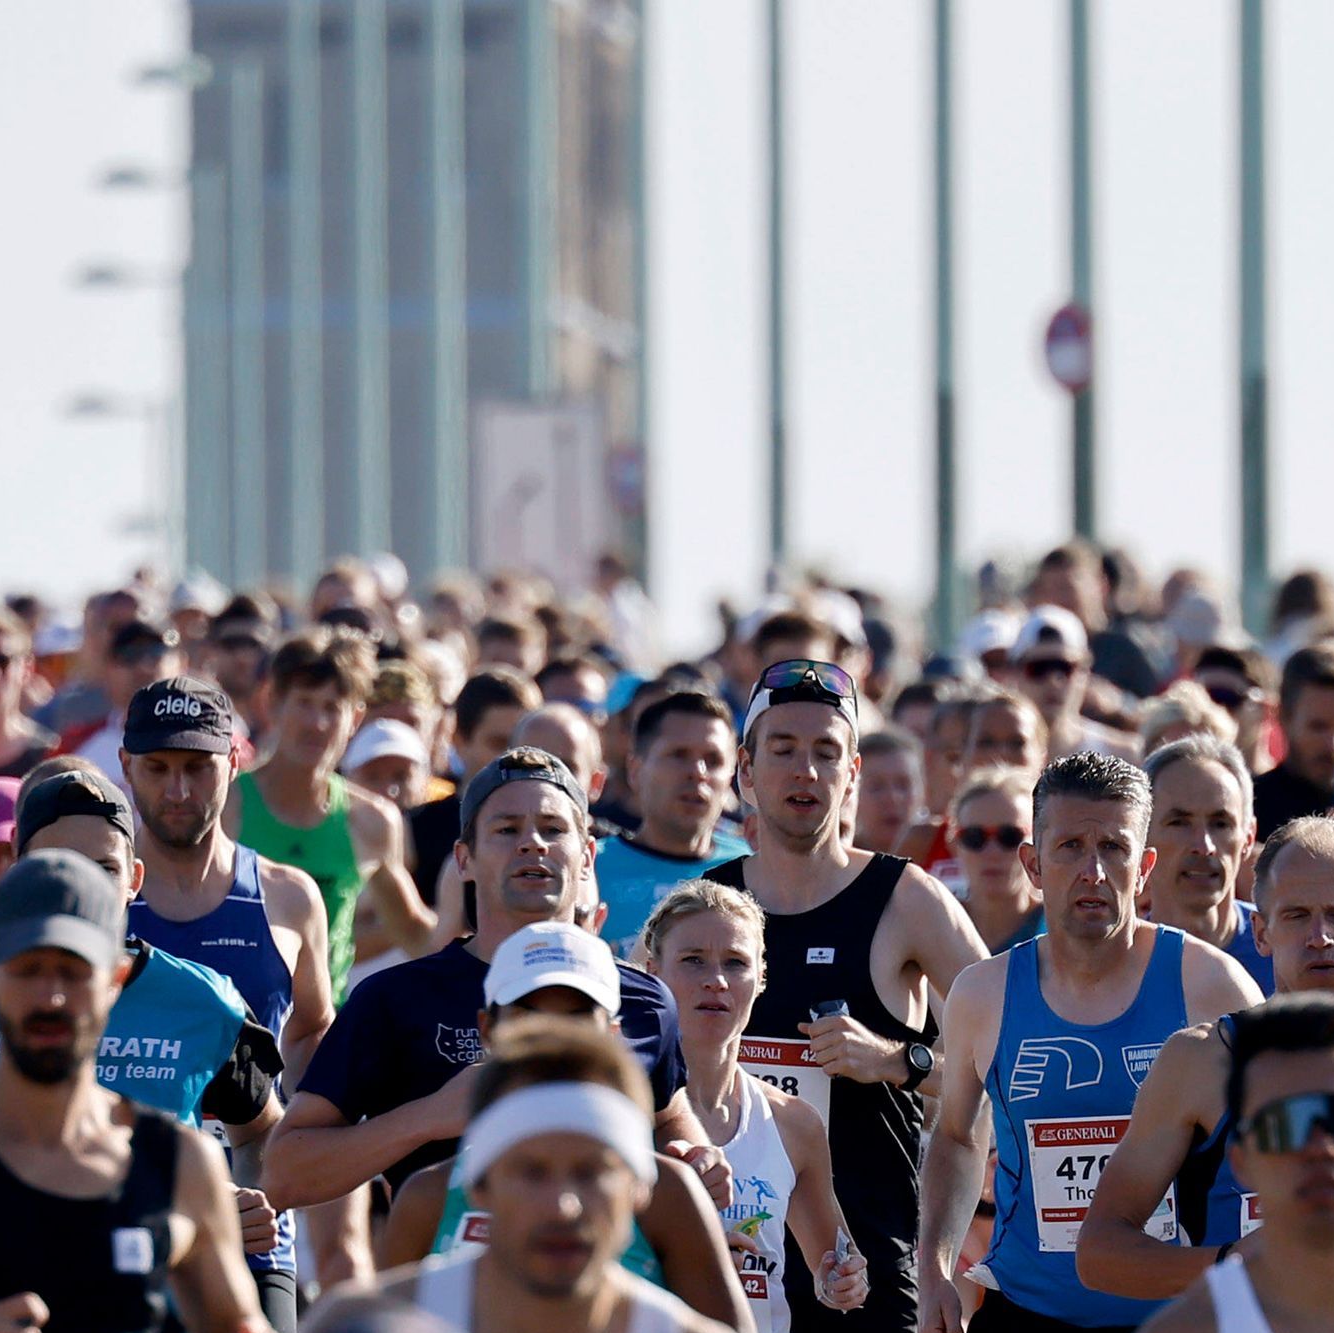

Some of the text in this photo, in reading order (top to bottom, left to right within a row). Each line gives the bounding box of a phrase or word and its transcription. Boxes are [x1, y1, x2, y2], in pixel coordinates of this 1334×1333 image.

[456, 1037, 483, 1051] squ
[738, 1045, 781, 1060] ENERALI
[96, 1062, 176, 1081] ng team
[1057, 1126, 1117, 1141] GENERALI
[734, 1178, 747, 1195] V
[1064, 1186, 1095, 1201] Tho
